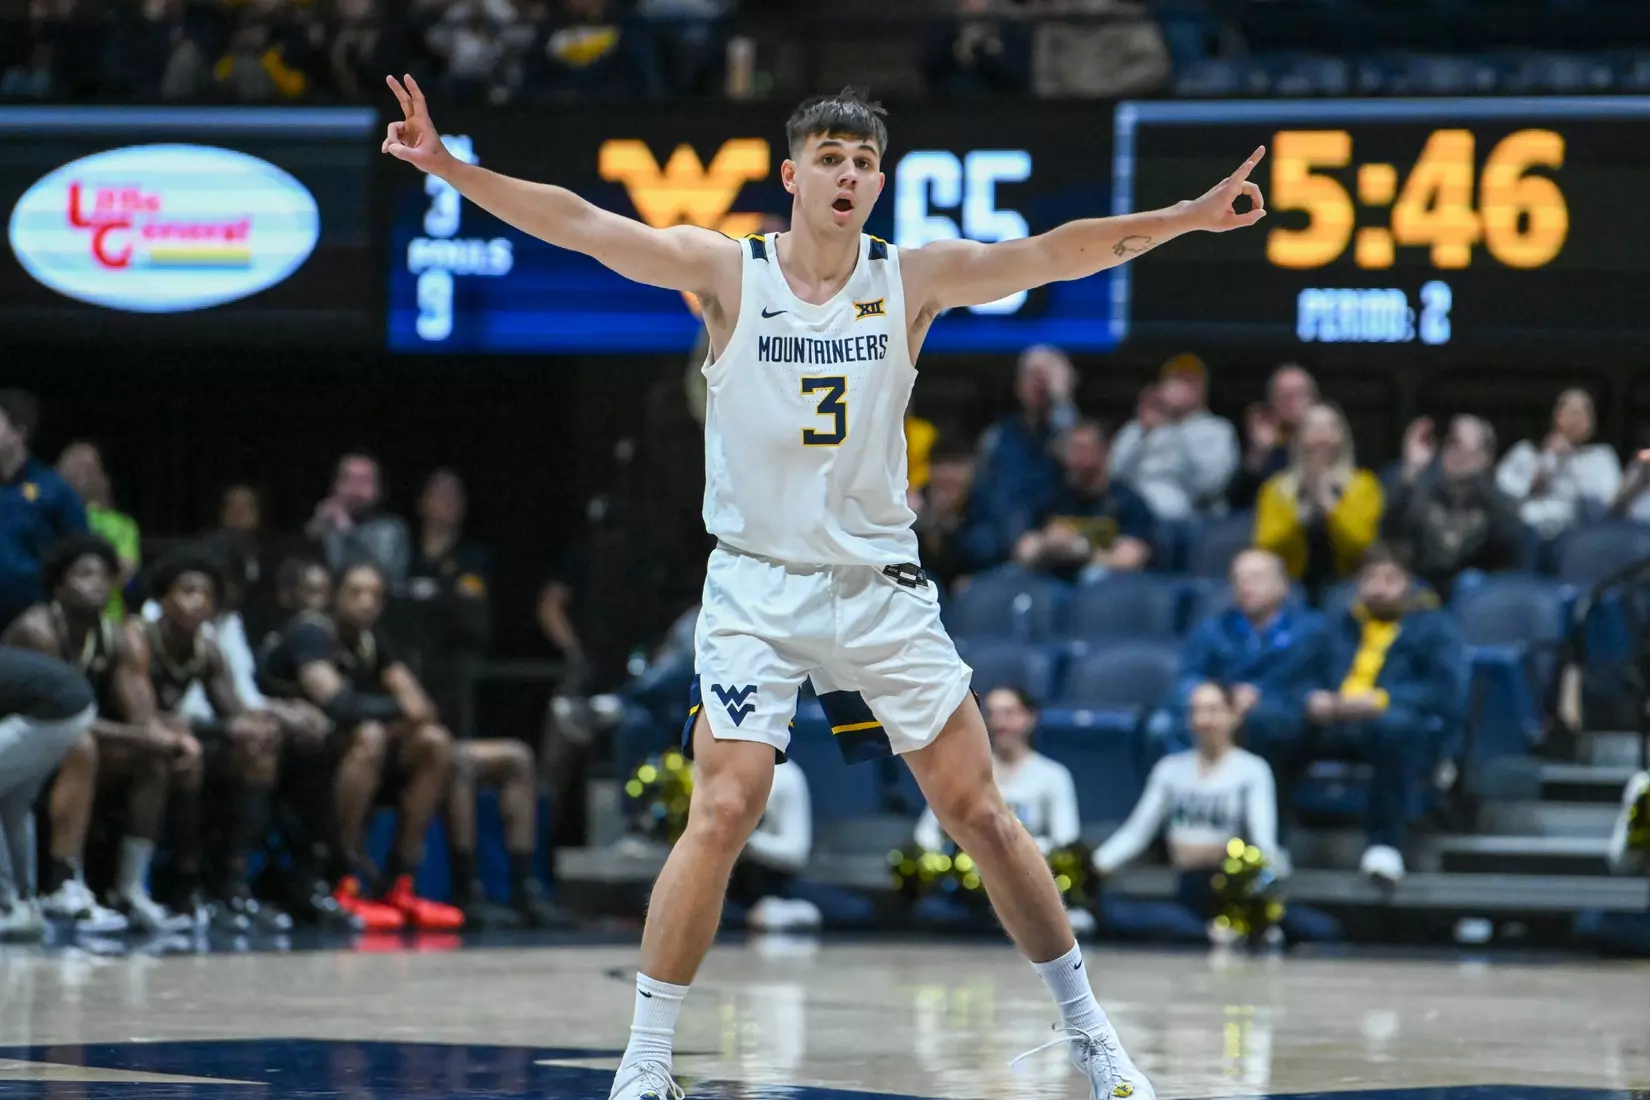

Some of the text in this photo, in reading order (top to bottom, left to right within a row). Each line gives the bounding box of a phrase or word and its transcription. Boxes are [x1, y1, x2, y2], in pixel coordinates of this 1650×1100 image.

[894, 150, 1033, 315] 65
[1266, 129, 1569, 269] 5:46
[1419, 280, 1452, 345] 2
[758, 334, 888, 365] MOUNTAINEERS
[801, 374, 848, 446] 3
